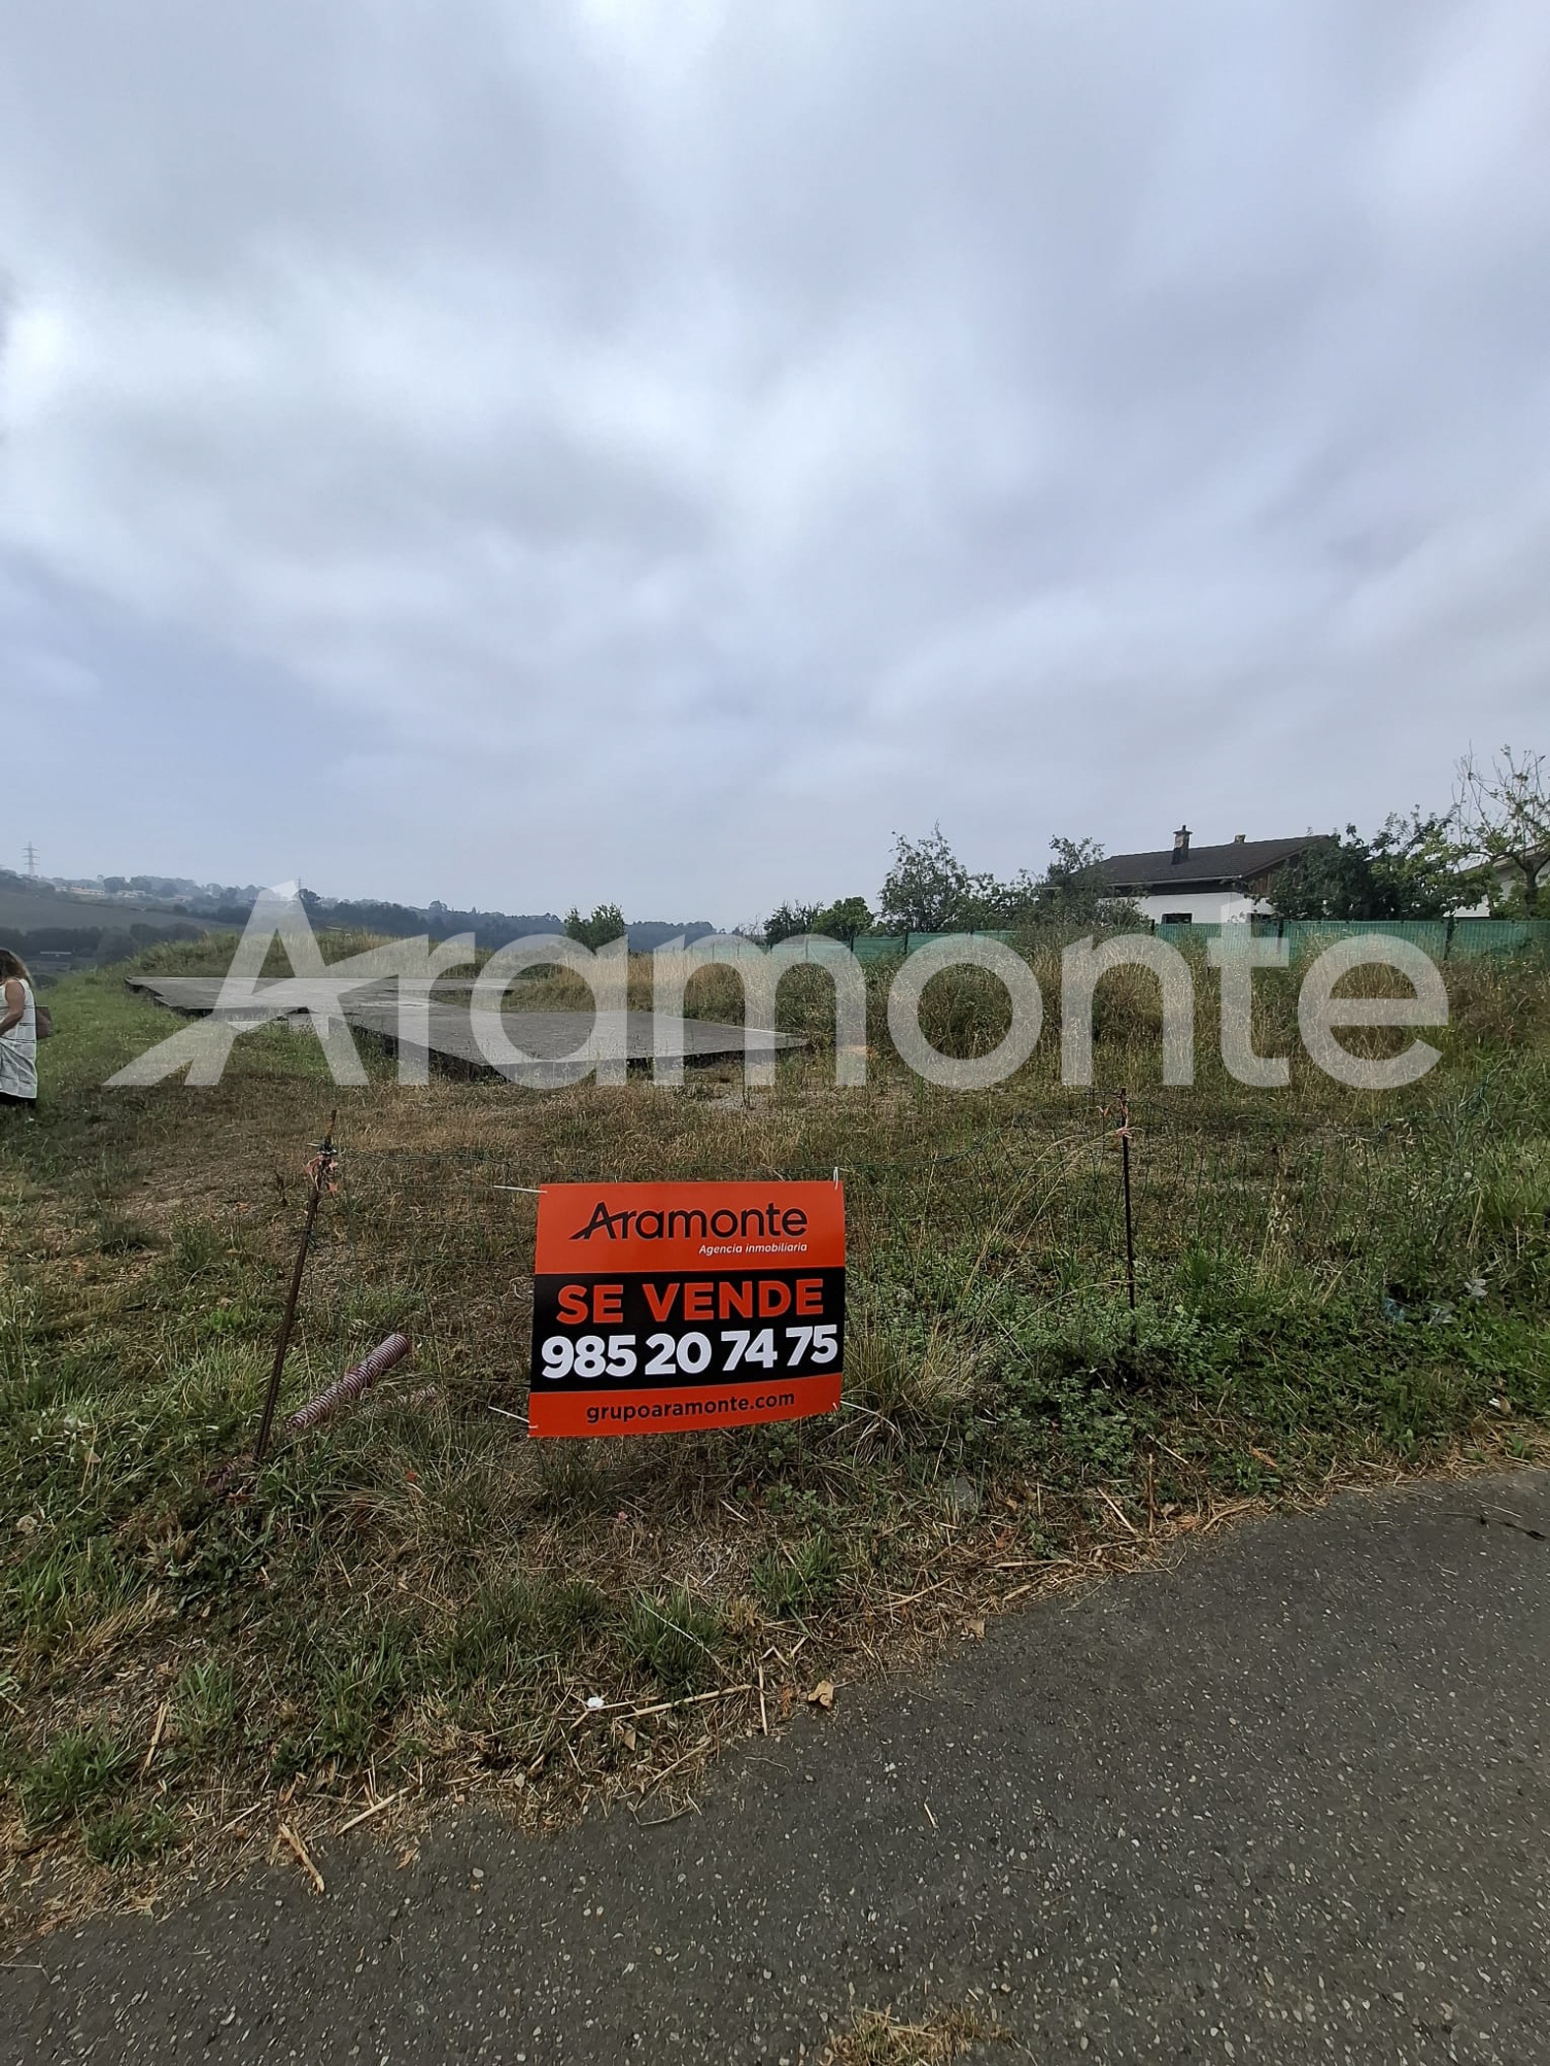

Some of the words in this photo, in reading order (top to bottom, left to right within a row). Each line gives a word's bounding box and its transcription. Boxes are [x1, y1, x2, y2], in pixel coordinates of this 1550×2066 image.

[568, 1201, 808, 1240] Aramonte
[699, 1243, 743, 1256] Agencia
[745, 1242, 808, 1254] inmobiliaria
[556, 1284, 624, 1325] SE
[642, 1278, 824, 1322] VENDE
[541, 1334, 638, 1379] 985
[644, 1331, 712, 1375] 20
[721, 1328, 778, 1372] 74
[786, 1324, 838, 1366] 75
[586, 1391, 795, 1424] grupoaramonte.com
